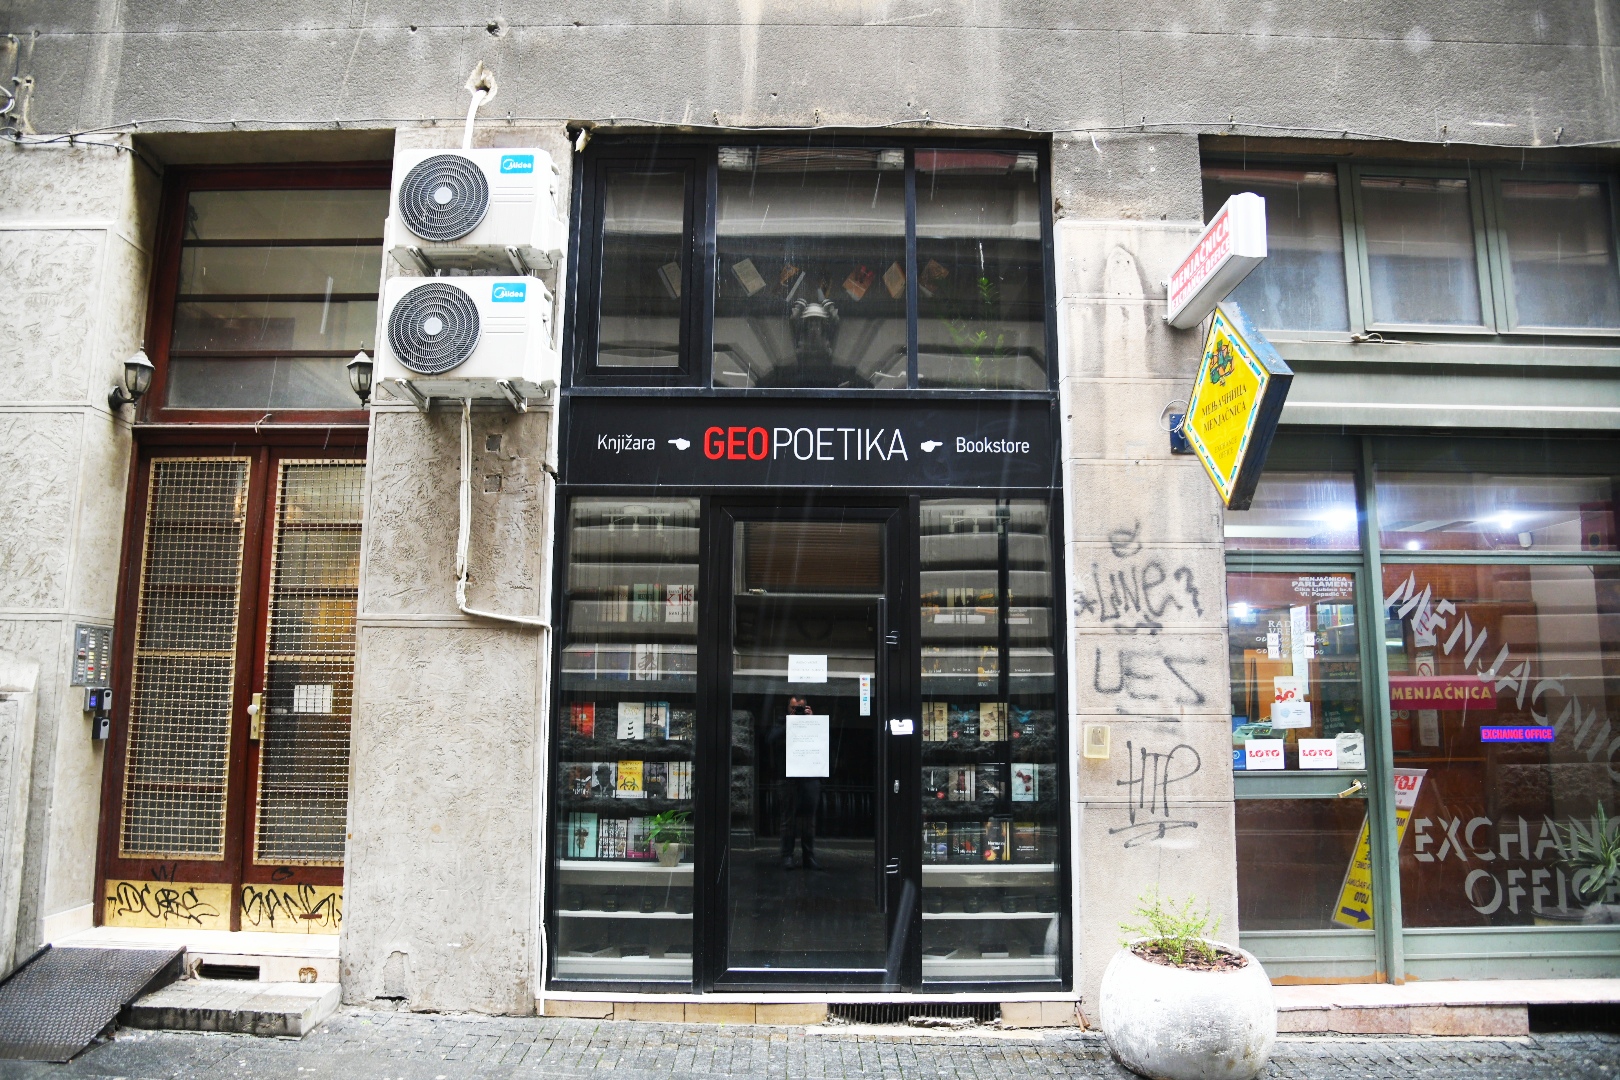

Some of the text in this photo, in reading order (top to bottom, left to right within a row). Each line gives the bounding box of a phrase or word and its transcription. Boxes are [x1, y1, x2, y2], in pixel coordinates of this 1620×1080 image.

[504, 160, 532, 170] Midea
[1172, 216, 1229, 293] MENJAČNICA
[1205, 237, 1230, 271] OFFICE
[496, 288, 524, 298] Midea
[1202, 384, 1247, 417] МЕЊАЧНИЦА
[1203, 401, 1247, 433] MENJAČNICA
[597, 426, 1031, 462] Knjižara GEOPOETIKA Bookstore
[1268, 620, 1310, 628] RADNO
[1391, 682, 1492, 700] MENJAČNICA
[1481, 729, 1553, 739] EXCHANGE OFFICE
[1249, 749, 1280, 758] LOTO
[1302, 749, 1333, 757] LOTO
